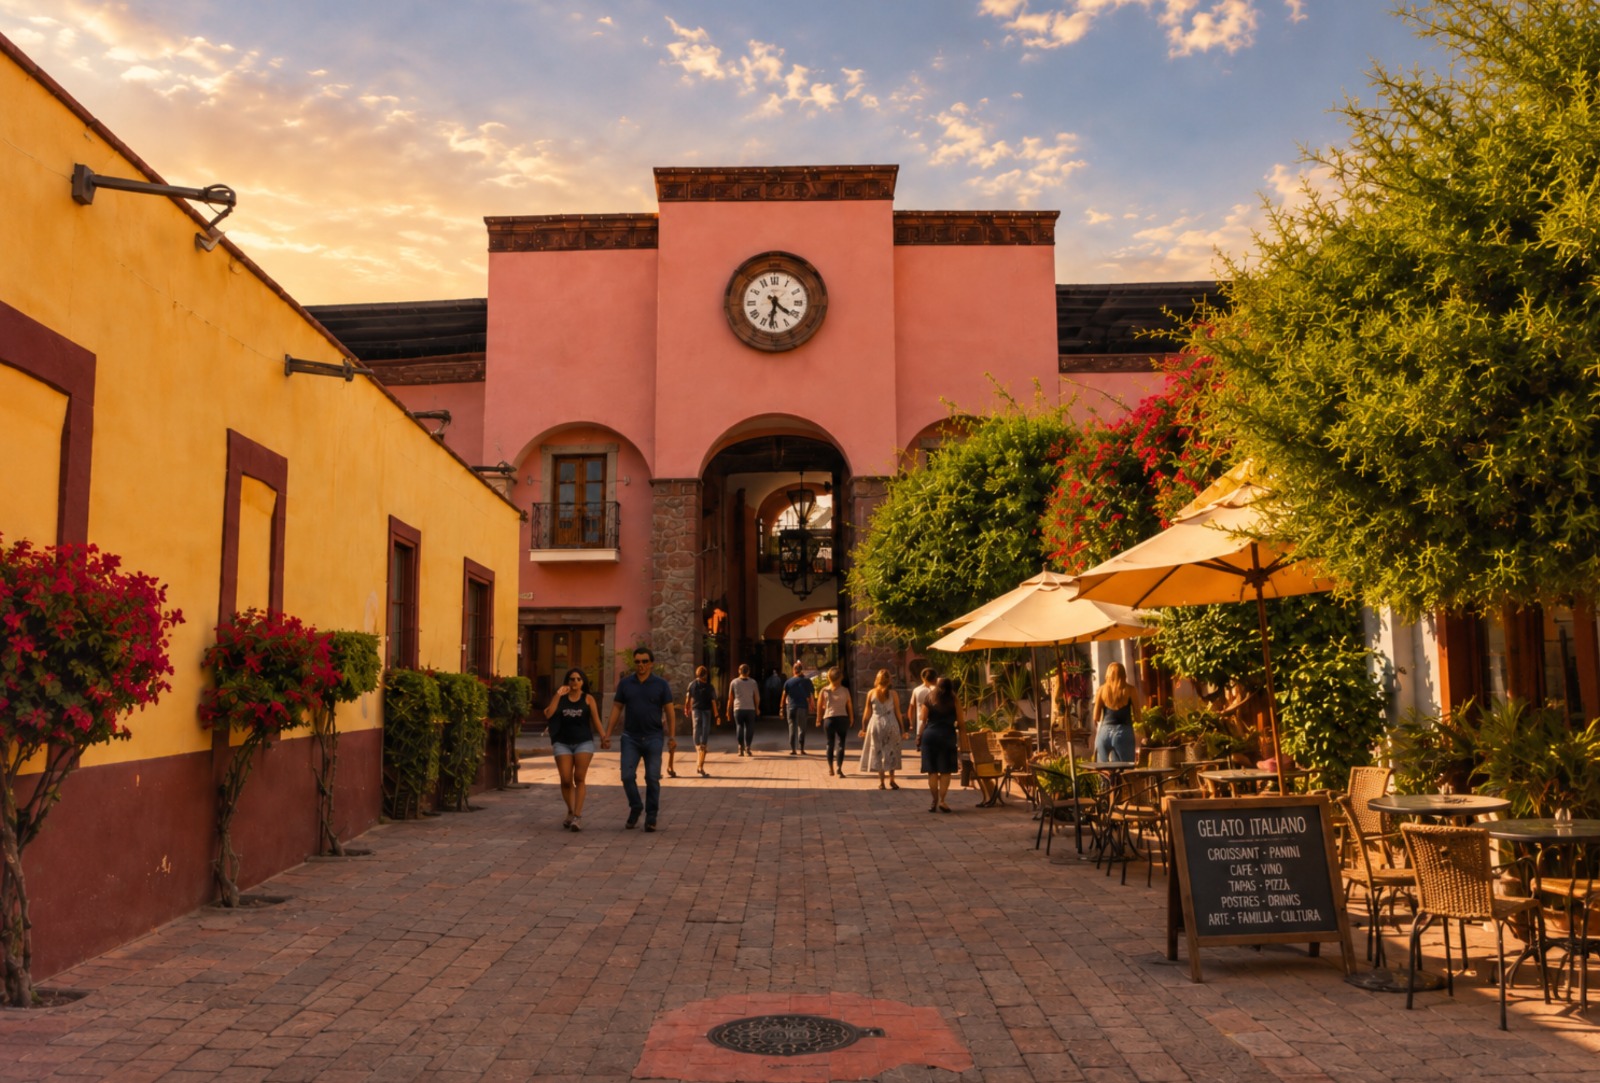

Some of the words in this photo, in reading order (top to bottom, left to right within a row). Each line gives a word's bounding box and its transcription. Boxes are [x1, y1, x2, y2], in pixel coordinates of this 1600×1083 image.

[1197, 819, 1245, 837] GELATO
[1249, 816, 1307, 836] ITALIANO
[1207, 847, 1260, 861] CROISSANT
[1269, 845, 1301, 859] PANINI
[1230, 864, 1253, 876] CAFE
[1260, 863, 1283, 875] VINO
[1228, 880, 1257, 892] TAPAS
[1264, 878, 1291, 891] PIZZA
[1220, 896, 1260, 908] POSTRES
[1267, 894, 1301, 907] DRINKS
[1208, 913, 1230, 926] ARTE
[1281, 909, 1321, 923] CULTURA
